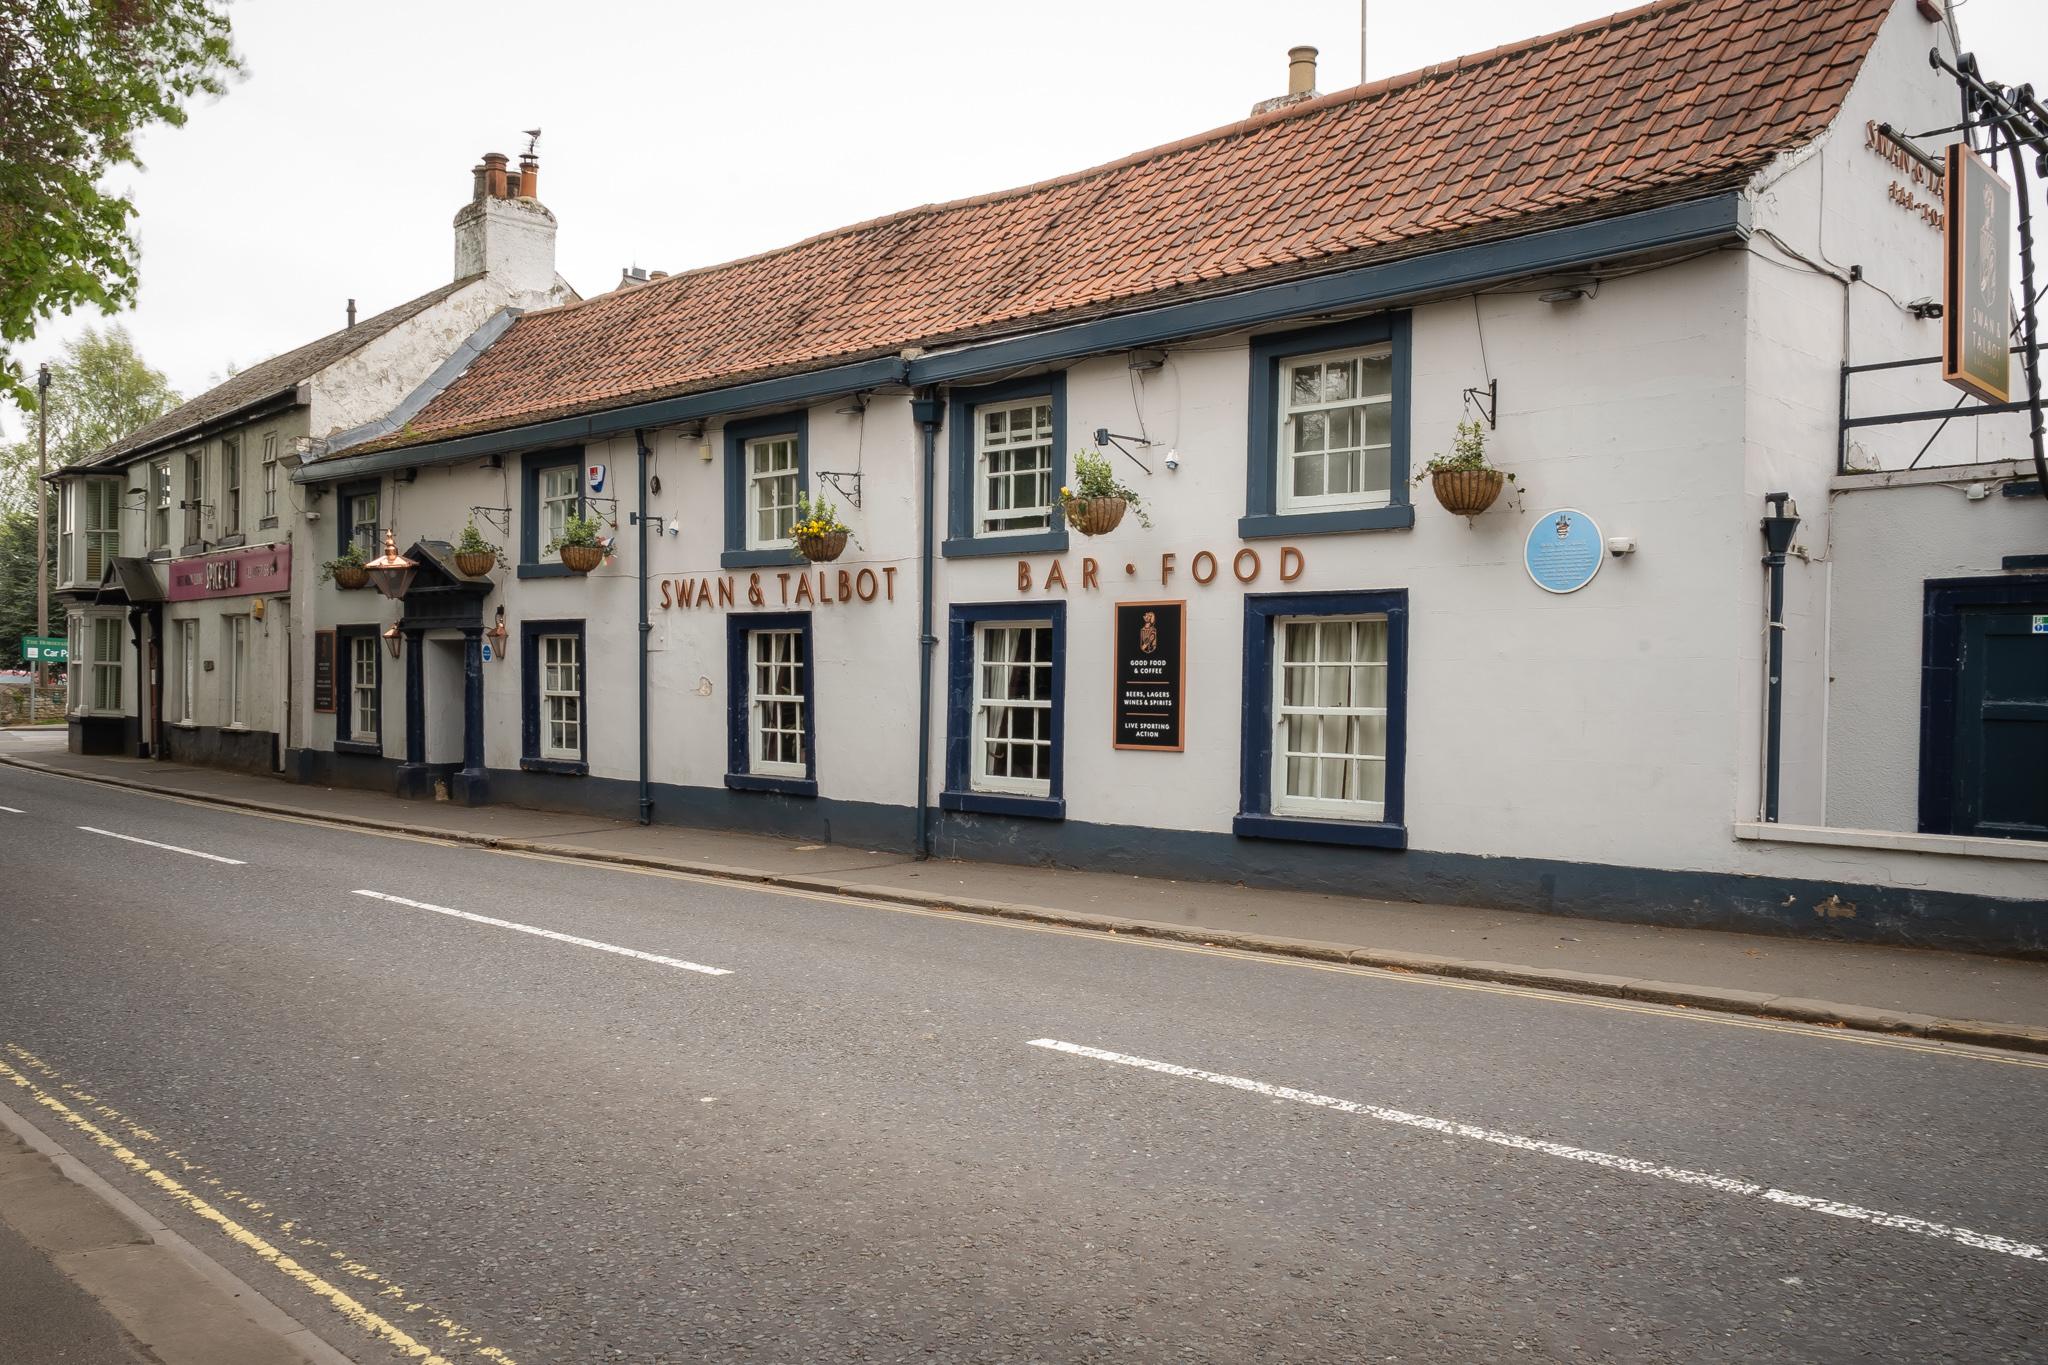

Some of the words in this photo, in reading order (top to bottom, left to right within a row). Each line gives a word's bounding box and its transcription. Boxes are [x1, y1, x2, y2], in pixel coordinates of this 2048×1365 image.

[660, 576, 736, 610] SWAN
[748, 572, 765, 607] &
[777, 566, 898, 607] TALBOT
[1017, 557, 1099, 592] BAR
[1162, 546, 1306, 586] FOOD
[43, 648, 59, 657] Car
